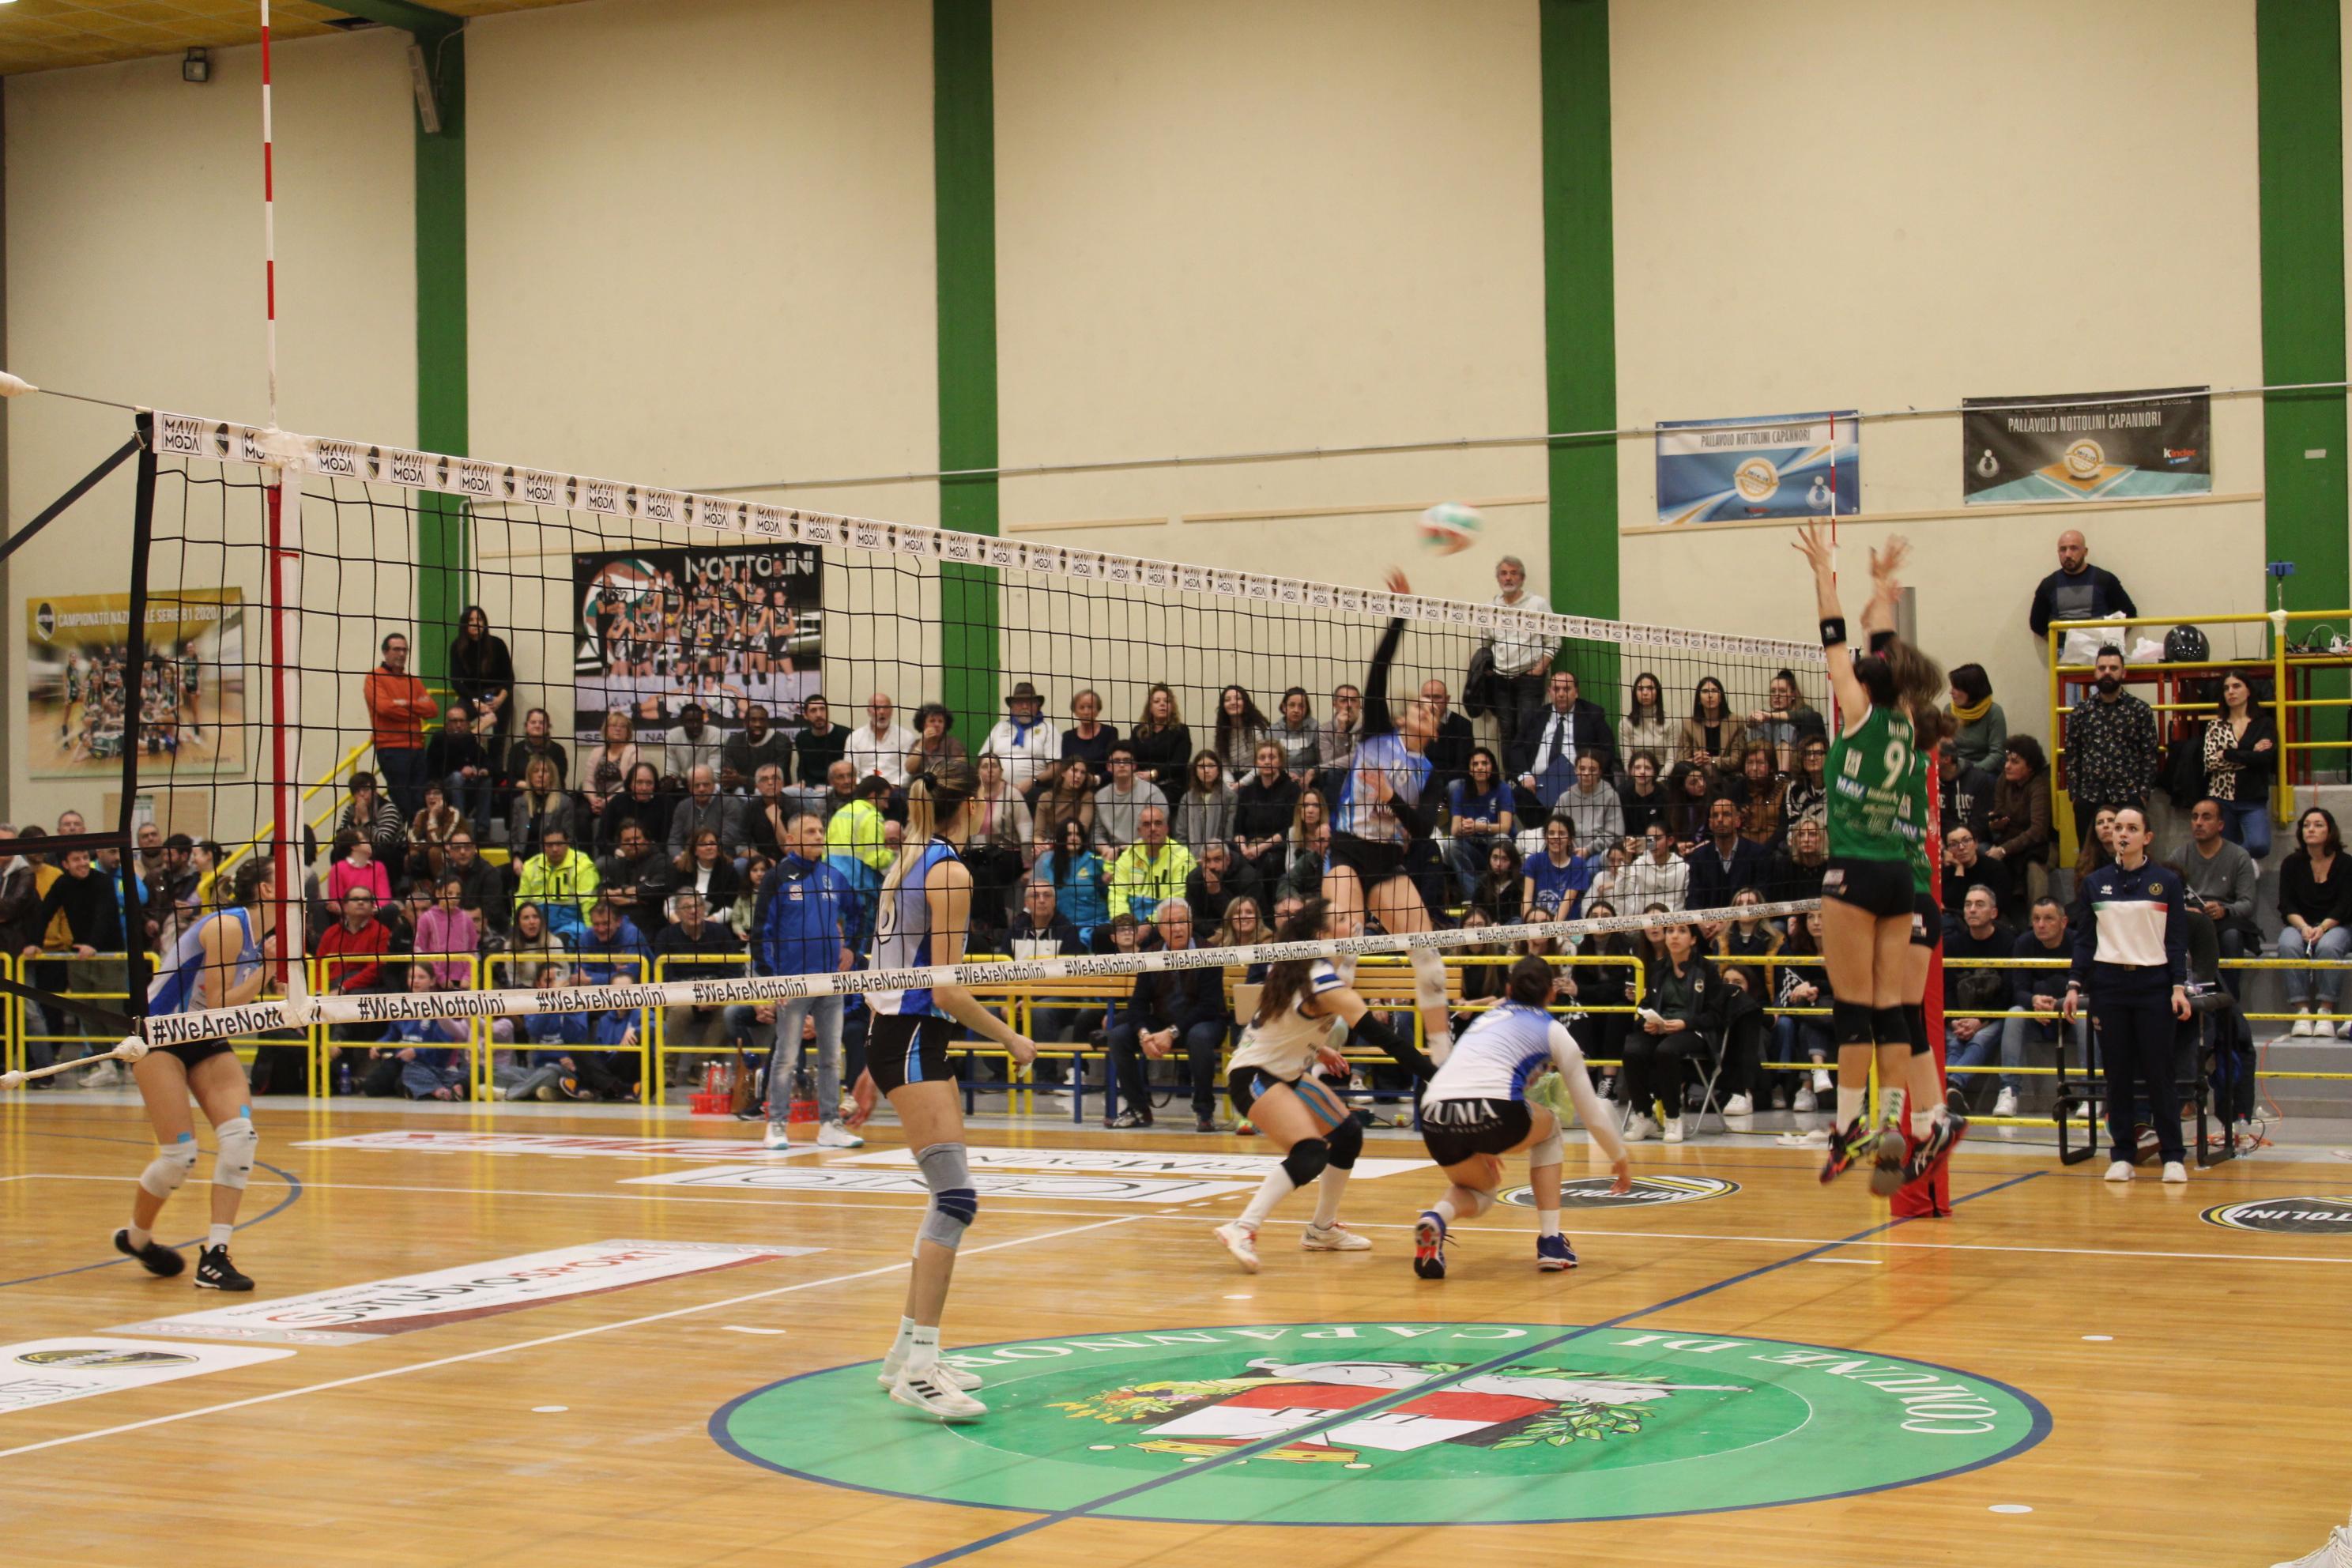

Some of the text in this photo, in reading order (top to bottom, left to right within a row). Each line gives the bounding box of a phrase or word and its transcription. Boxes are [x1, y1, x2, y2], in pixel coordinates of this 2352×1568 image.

[165, 416, 199, 436] MAVI
[2008, 411, 2161, 433] PALLAVOLO NOTTOLINI CAPANNORI
[165, 432, 199, 451] MODA
[1701, 428, 1811, 448] PALLAVOLO NOTTOLINI CAPANNORI
[318, 441, 354, 459] MAVI
[318, 455, 354, 473] MODA
[394, 453, 423, 469] MAVI
[394, 466, 423, 484] MODA
[462, 463, 491, 480] MAVI
[462, 477, 491, 493] MODA
[526, 473, 554, 488] MAVI
[526, 486, 554, 502] MODA
[589, 482, 615, 498] MAVI
[589, 495, 615, 511] MODA
[647, 491, 672, 506] MAVI
[704, 499, 727, 514] MAVI
[647, 503, 672, 518] MODA
[704, 511, 727, 526] MODA
[757, 507, 780, 521] MAVI
[757, 518, 780, 533] MODA
[808, 514, 831, 528] MAVI
[858, 522, 878, 534] MAVI
[808, 526, 831, 540] MODA
[858, 533, 878, 546] MODA
[904, 528, 925, 541] MAVI
[949, 534, 968, 547] MAVI
[904, 539, 925, 552] MODA
[949, 545, 968, 558] MODA
[993, 541, 1011, 552] MAVI
[993, 551, 1011, 563] MODA
[1034, 556, 1051, 568] MODA
[685, 550, 814, 582] NOTTOLINI
[58, 612, 110, 628] CAMPIONATO
[111, 609, 156, 627] NAZILE
[157, 607, 181, 623] SERIE
[1880, 739, 1906, 791] 9
[1253, 942, 1321, 963] #WeAreNottolini
[1335, 937, 1396, 956] #WeAreNottolini
[1065, 955, 1146, 977] #WeAreNottolini
[1163, 948, 1238, 970] #WeAreNottolini
[955, 962, 1045, 984] #WeAreNottolini
[831, 969, 933, 995] #WeAreNottolini
[536, 986, 666, 1012] #WeAreNottolini
[692, 978, 807, 1004] #WeAreNottolini
[357, 993, 504, 1021] #WeAreNottolini
[325, 1250, 673, 1311] STUDIOSPORT
[940, 1325, 1997, 1435] COMUNE DI CAPANNOR
